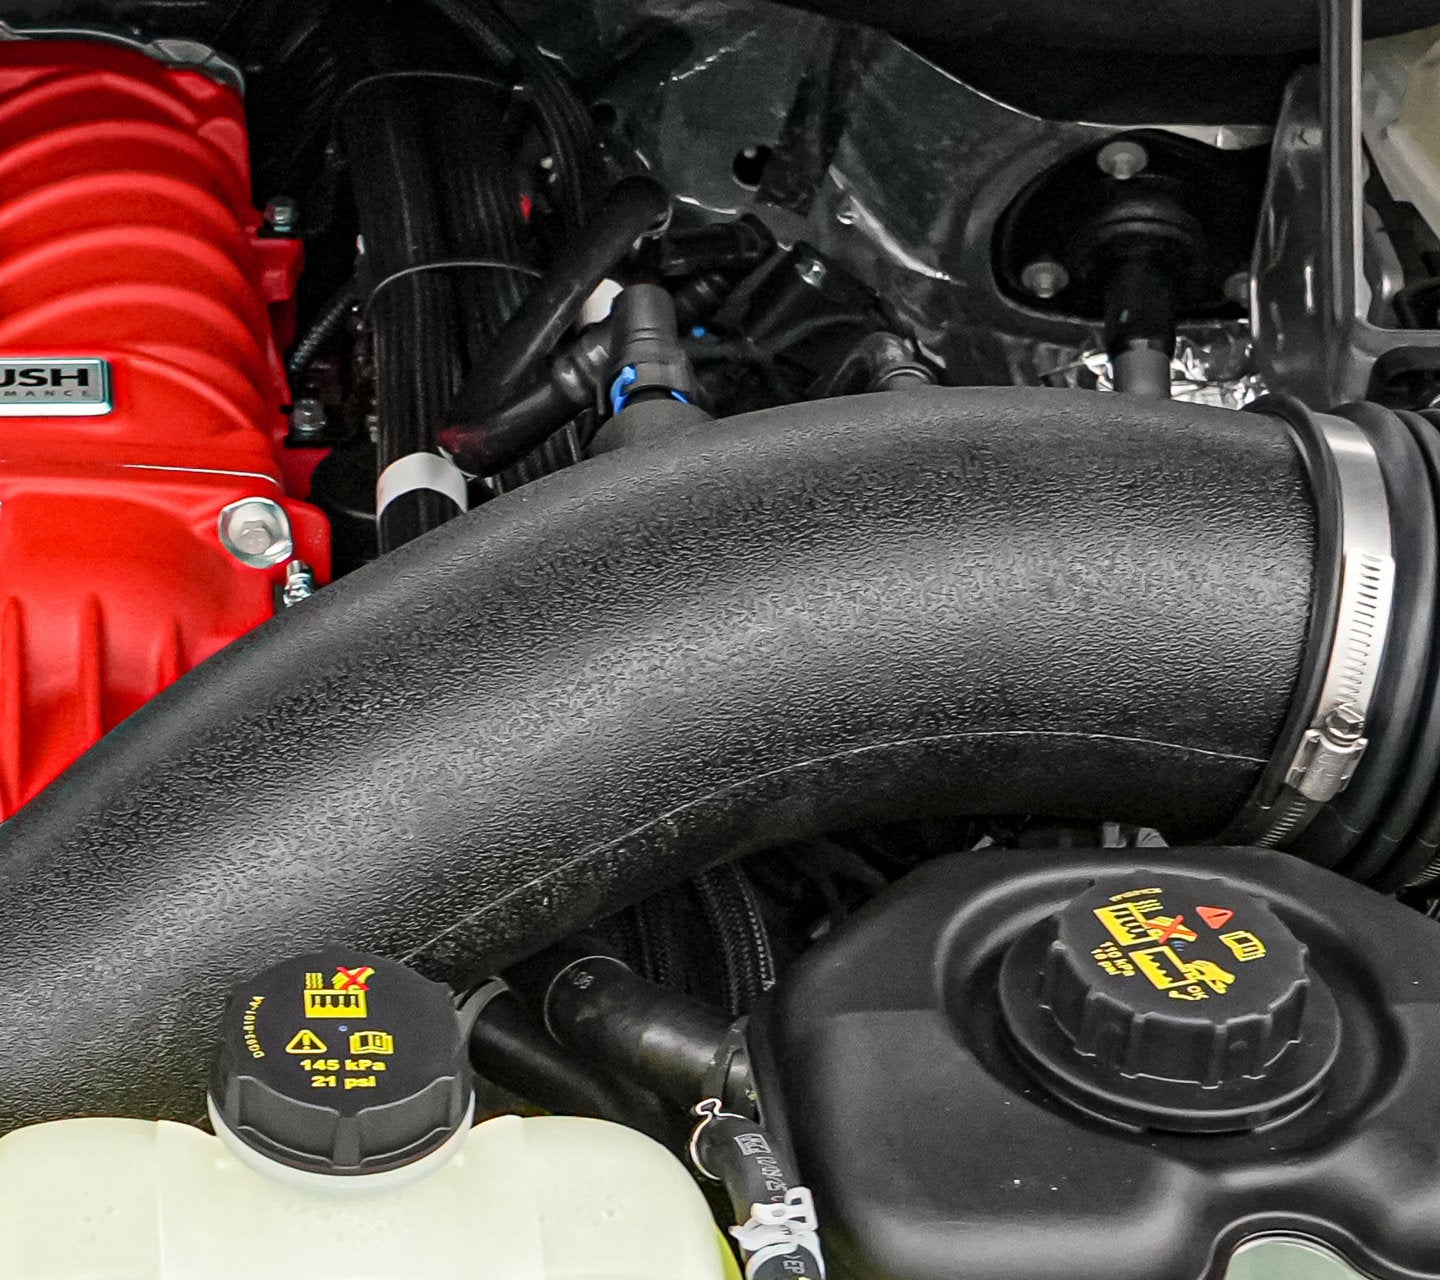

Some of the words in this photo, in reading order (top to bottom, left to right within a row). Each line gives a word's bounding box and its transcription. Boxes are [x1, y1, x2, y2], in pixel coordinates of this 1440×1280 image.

[299, 1058, 340, 1071] 145
[344, 1058, 387, 1072] kPa
[310, 1075, 337, 1088] 21
[343, 1076, 376, 1090] psi
